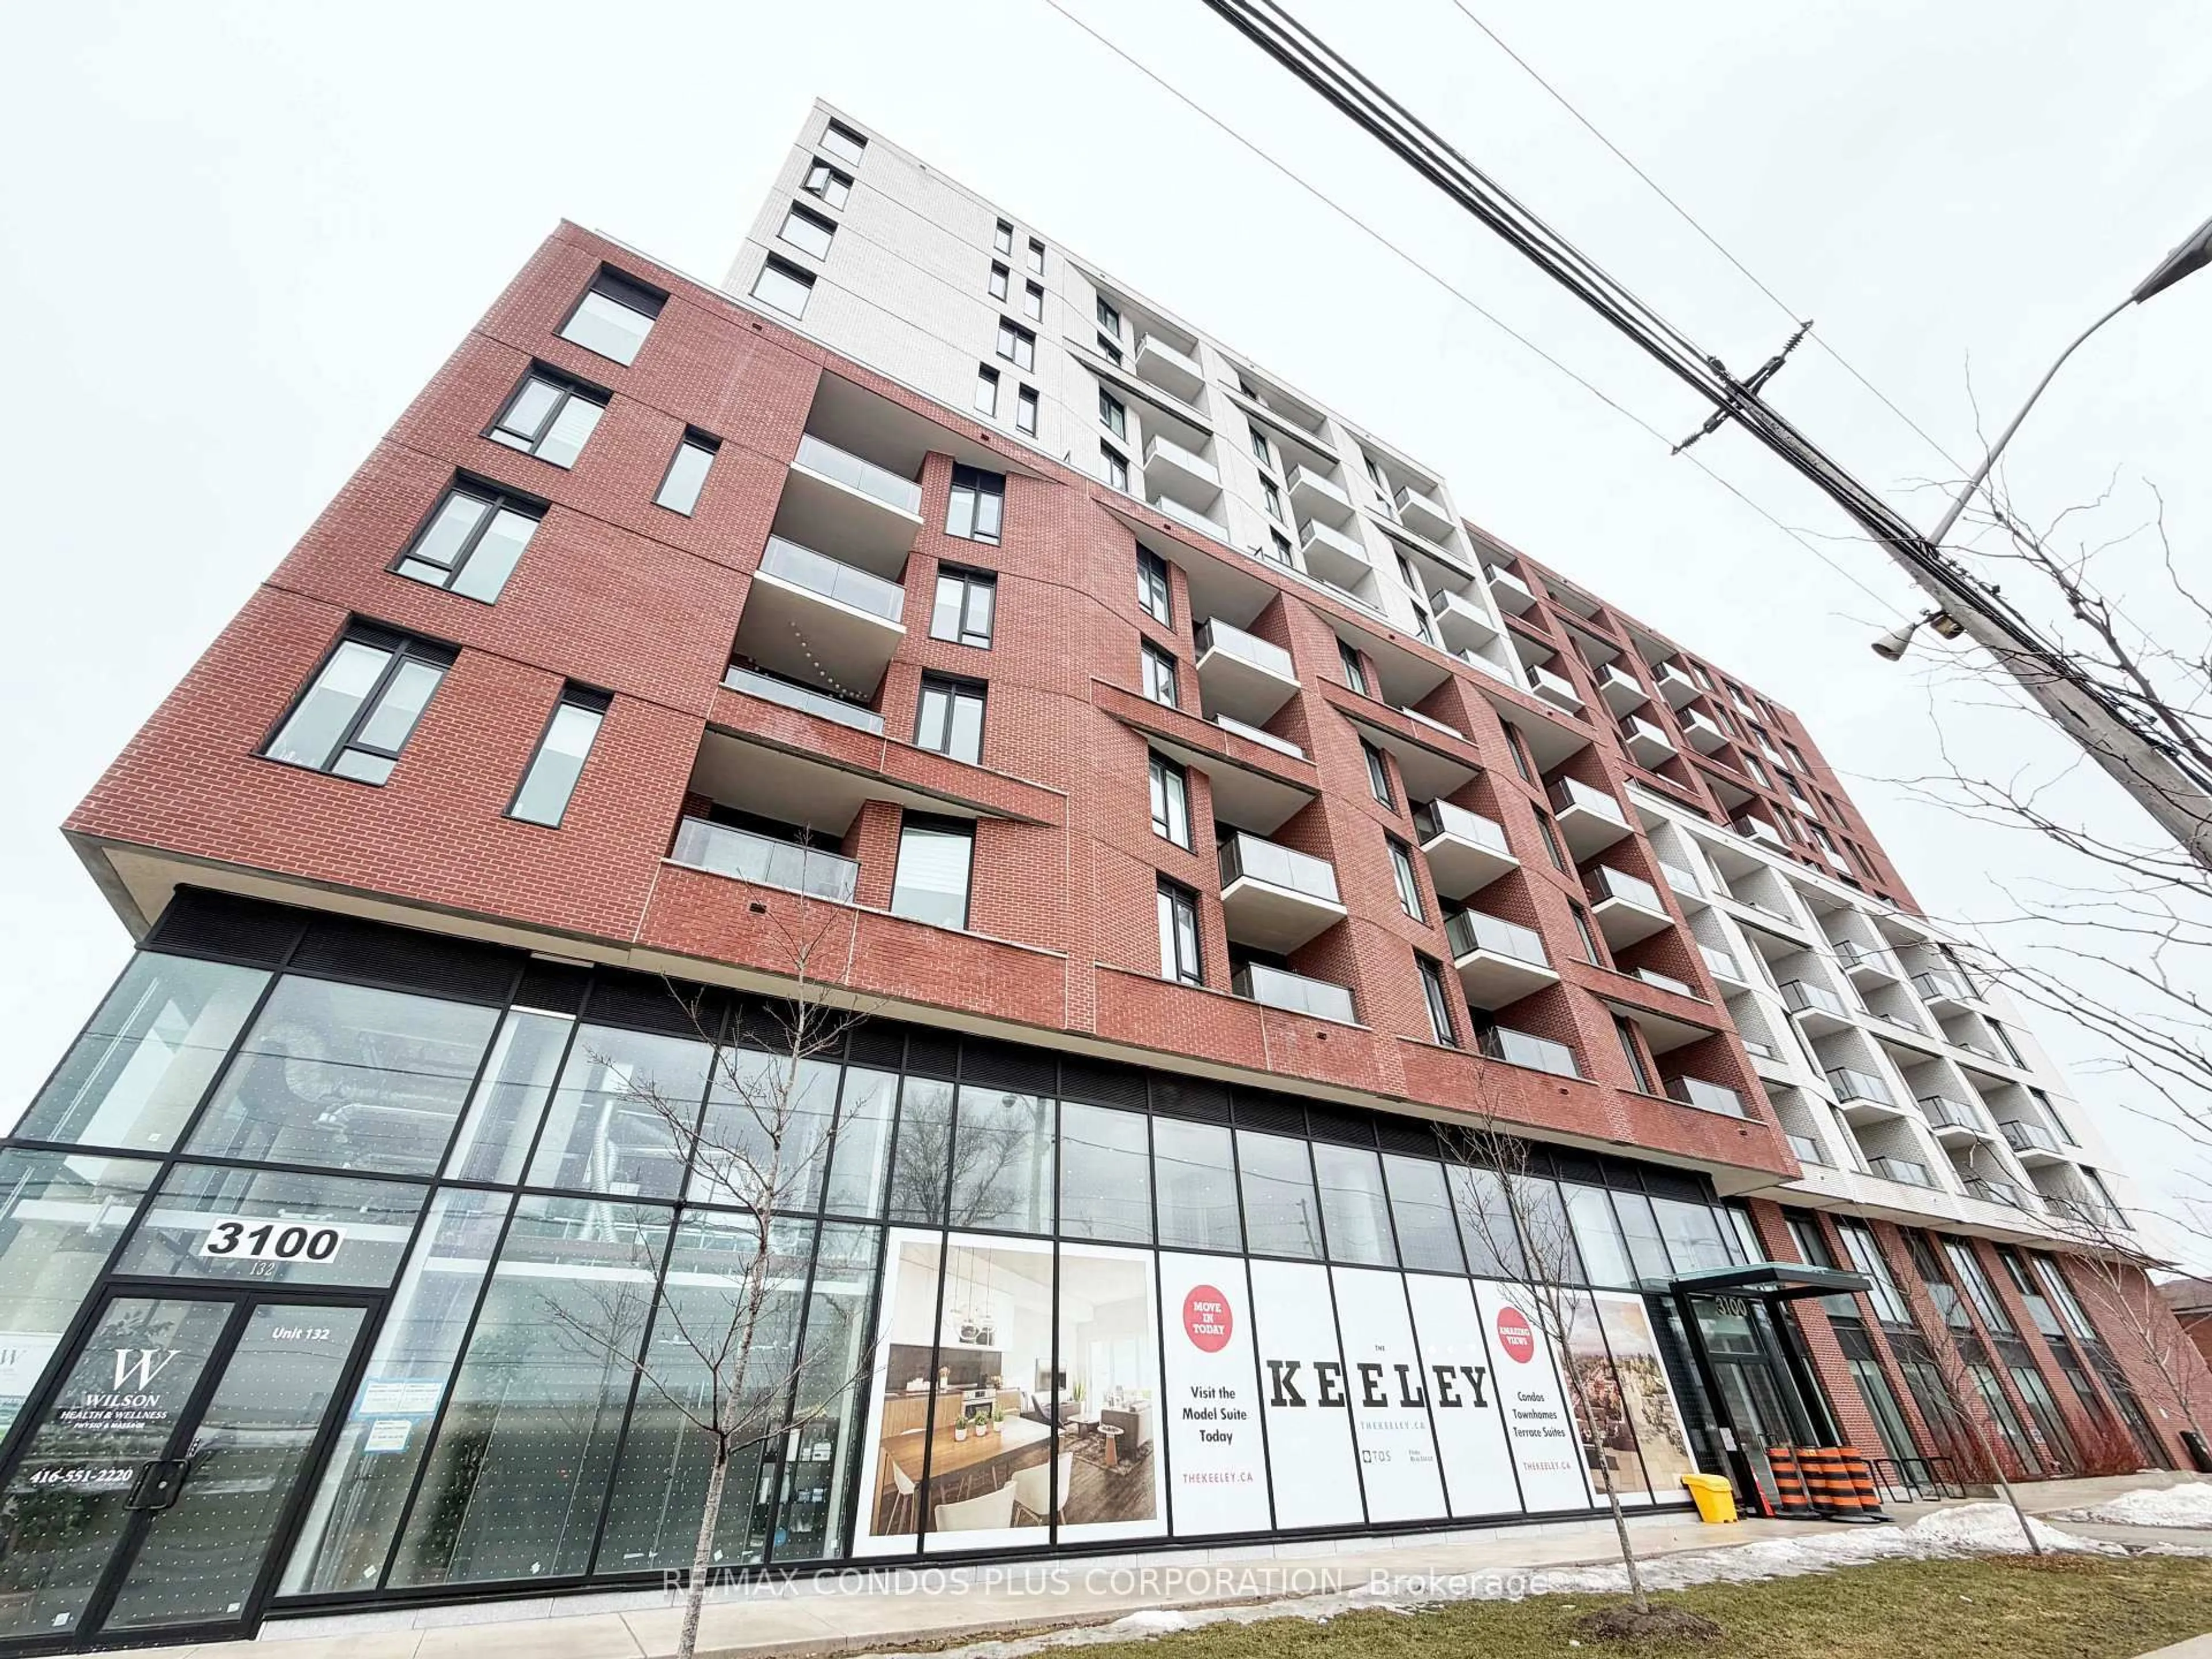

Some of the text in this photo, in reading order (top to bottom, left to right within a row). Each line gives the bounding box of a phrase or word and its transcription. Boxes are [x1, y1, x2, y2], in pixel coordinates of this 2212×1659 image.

[207, 1222, 339, 1260] 3100
[249, 1262, 275, 1275] 132
[1194, 1302, 1222, 1313] MOVE
[1715, 1295, 1747, 1316] 3100
[1203, 1313, 1214, 1323] IN
[272, 1328, 330, 1340] Unit 132
[1192, 1324, 1225, 1335] TODAY
[115, 1349, 183, 1391] W
[1267, 1359, 1488, 1408] KEELEY
[1191, 1385, 1236, 1399] Visit the
[1517, 1391, 1545, 1402] Condos
[85, 1394, 161, 1407] WILSON
[60, 1411, 104, 1419] HEALTH
[115, 1411, 166, 1419] WELLNESS
[1183, 1407, 1247, 1421] Model Suite
[1512, 1408, 1558, 1419] Townhomes
[1199, 1429, 1233, 1446] Today
[1513, 1426, 1566, 1437] Terrace Suites
[29, 1469, 133, 1483] 416-551-2220
[1183, 1471, 1253, 1483] THEKEELEY.CA
